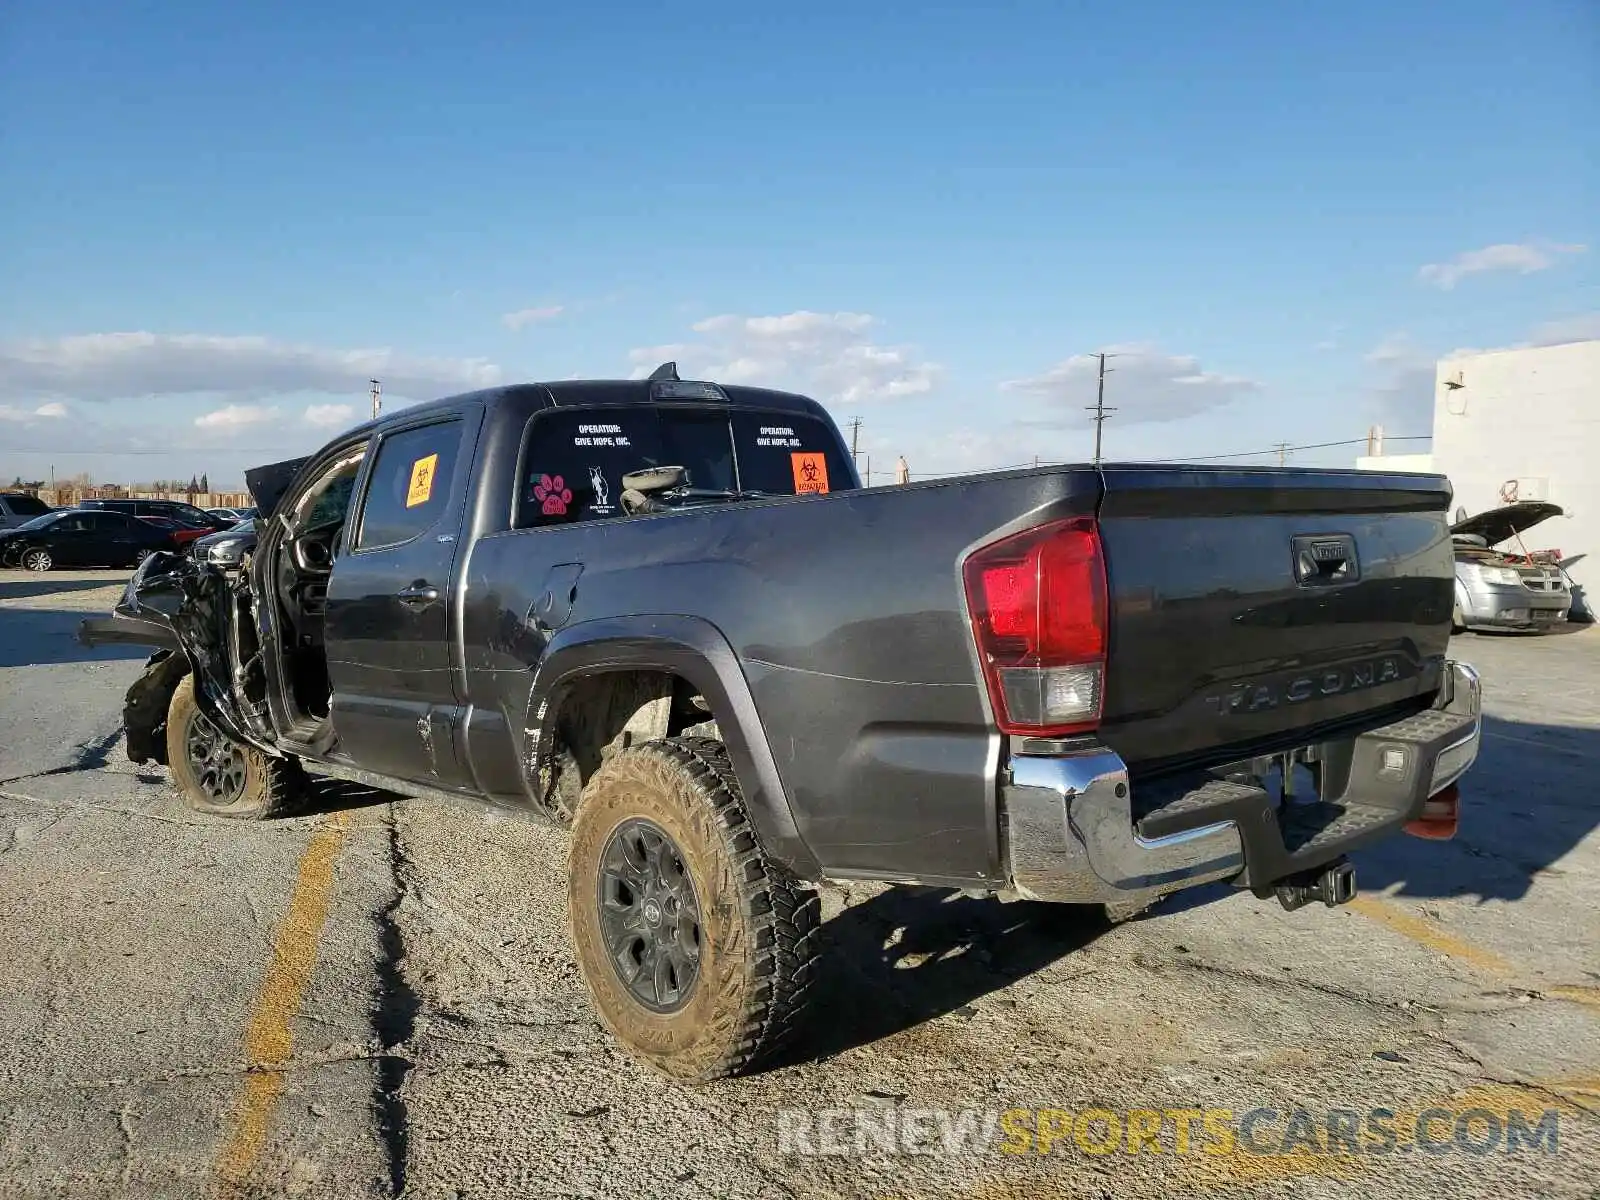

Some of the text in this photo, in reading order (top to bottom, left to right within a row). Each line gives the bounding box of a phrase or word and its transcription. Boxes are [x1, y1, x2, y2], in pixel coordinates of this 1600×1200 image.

[578, 424, 622, 434] OPERATION:
[574, 437, 592, 446] GIVE
[1205, 658, 1400, 716] TACOMA
